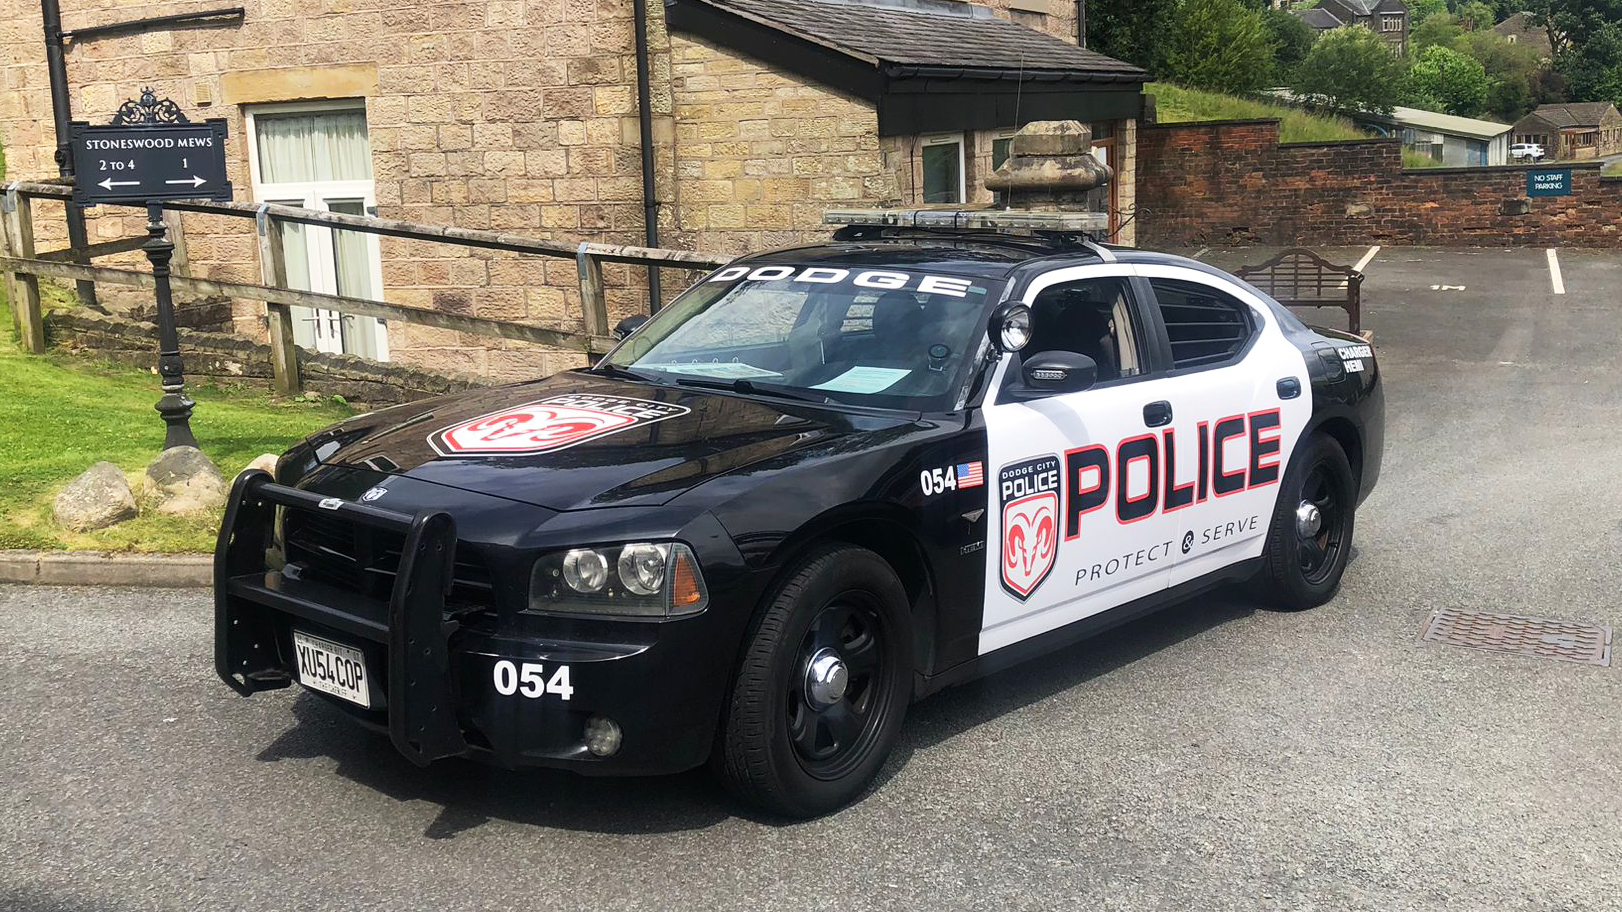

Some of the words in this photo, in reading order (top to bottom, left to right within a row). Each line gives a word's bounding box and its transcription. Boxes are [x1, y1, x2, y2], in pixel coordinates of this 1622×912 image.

[86, 138, 174, 150] STONESWOOD
[177, 137, 213, 148] MEWS
[99, 160, 107, 171] 2
[110, 161, 124, 170] TO
[127, 160, 135, 170] 4
[182, 158, 188, 169] 1
[1534, 174, 1545, 182] NO
[1546, 173, 1564, 181] STAFF
[1534, 182, 1563, 190] PARKING
[709, 266, 972, 298] DODGE
[1337, 345, 1373, 360] CHARGER
[1343, 359, 1365, 374] HEMI
[541, 398, 669, 419] POLICE
[1002, 465, 1034, 479] DODGE
[1036, 460, 1056, 471] CITY
[1064, 406, 1281, 542] POLICE
[920, 465, 957, 496] 054
[1002, 469, 1058, 501] POLICE
[1075, 540, 1173, 586] PROTECT
[1201, 515, 1259, 545] SERVE
[297, 644, 363, 693] XU54COP
[493, 660, 574, 700] 054
